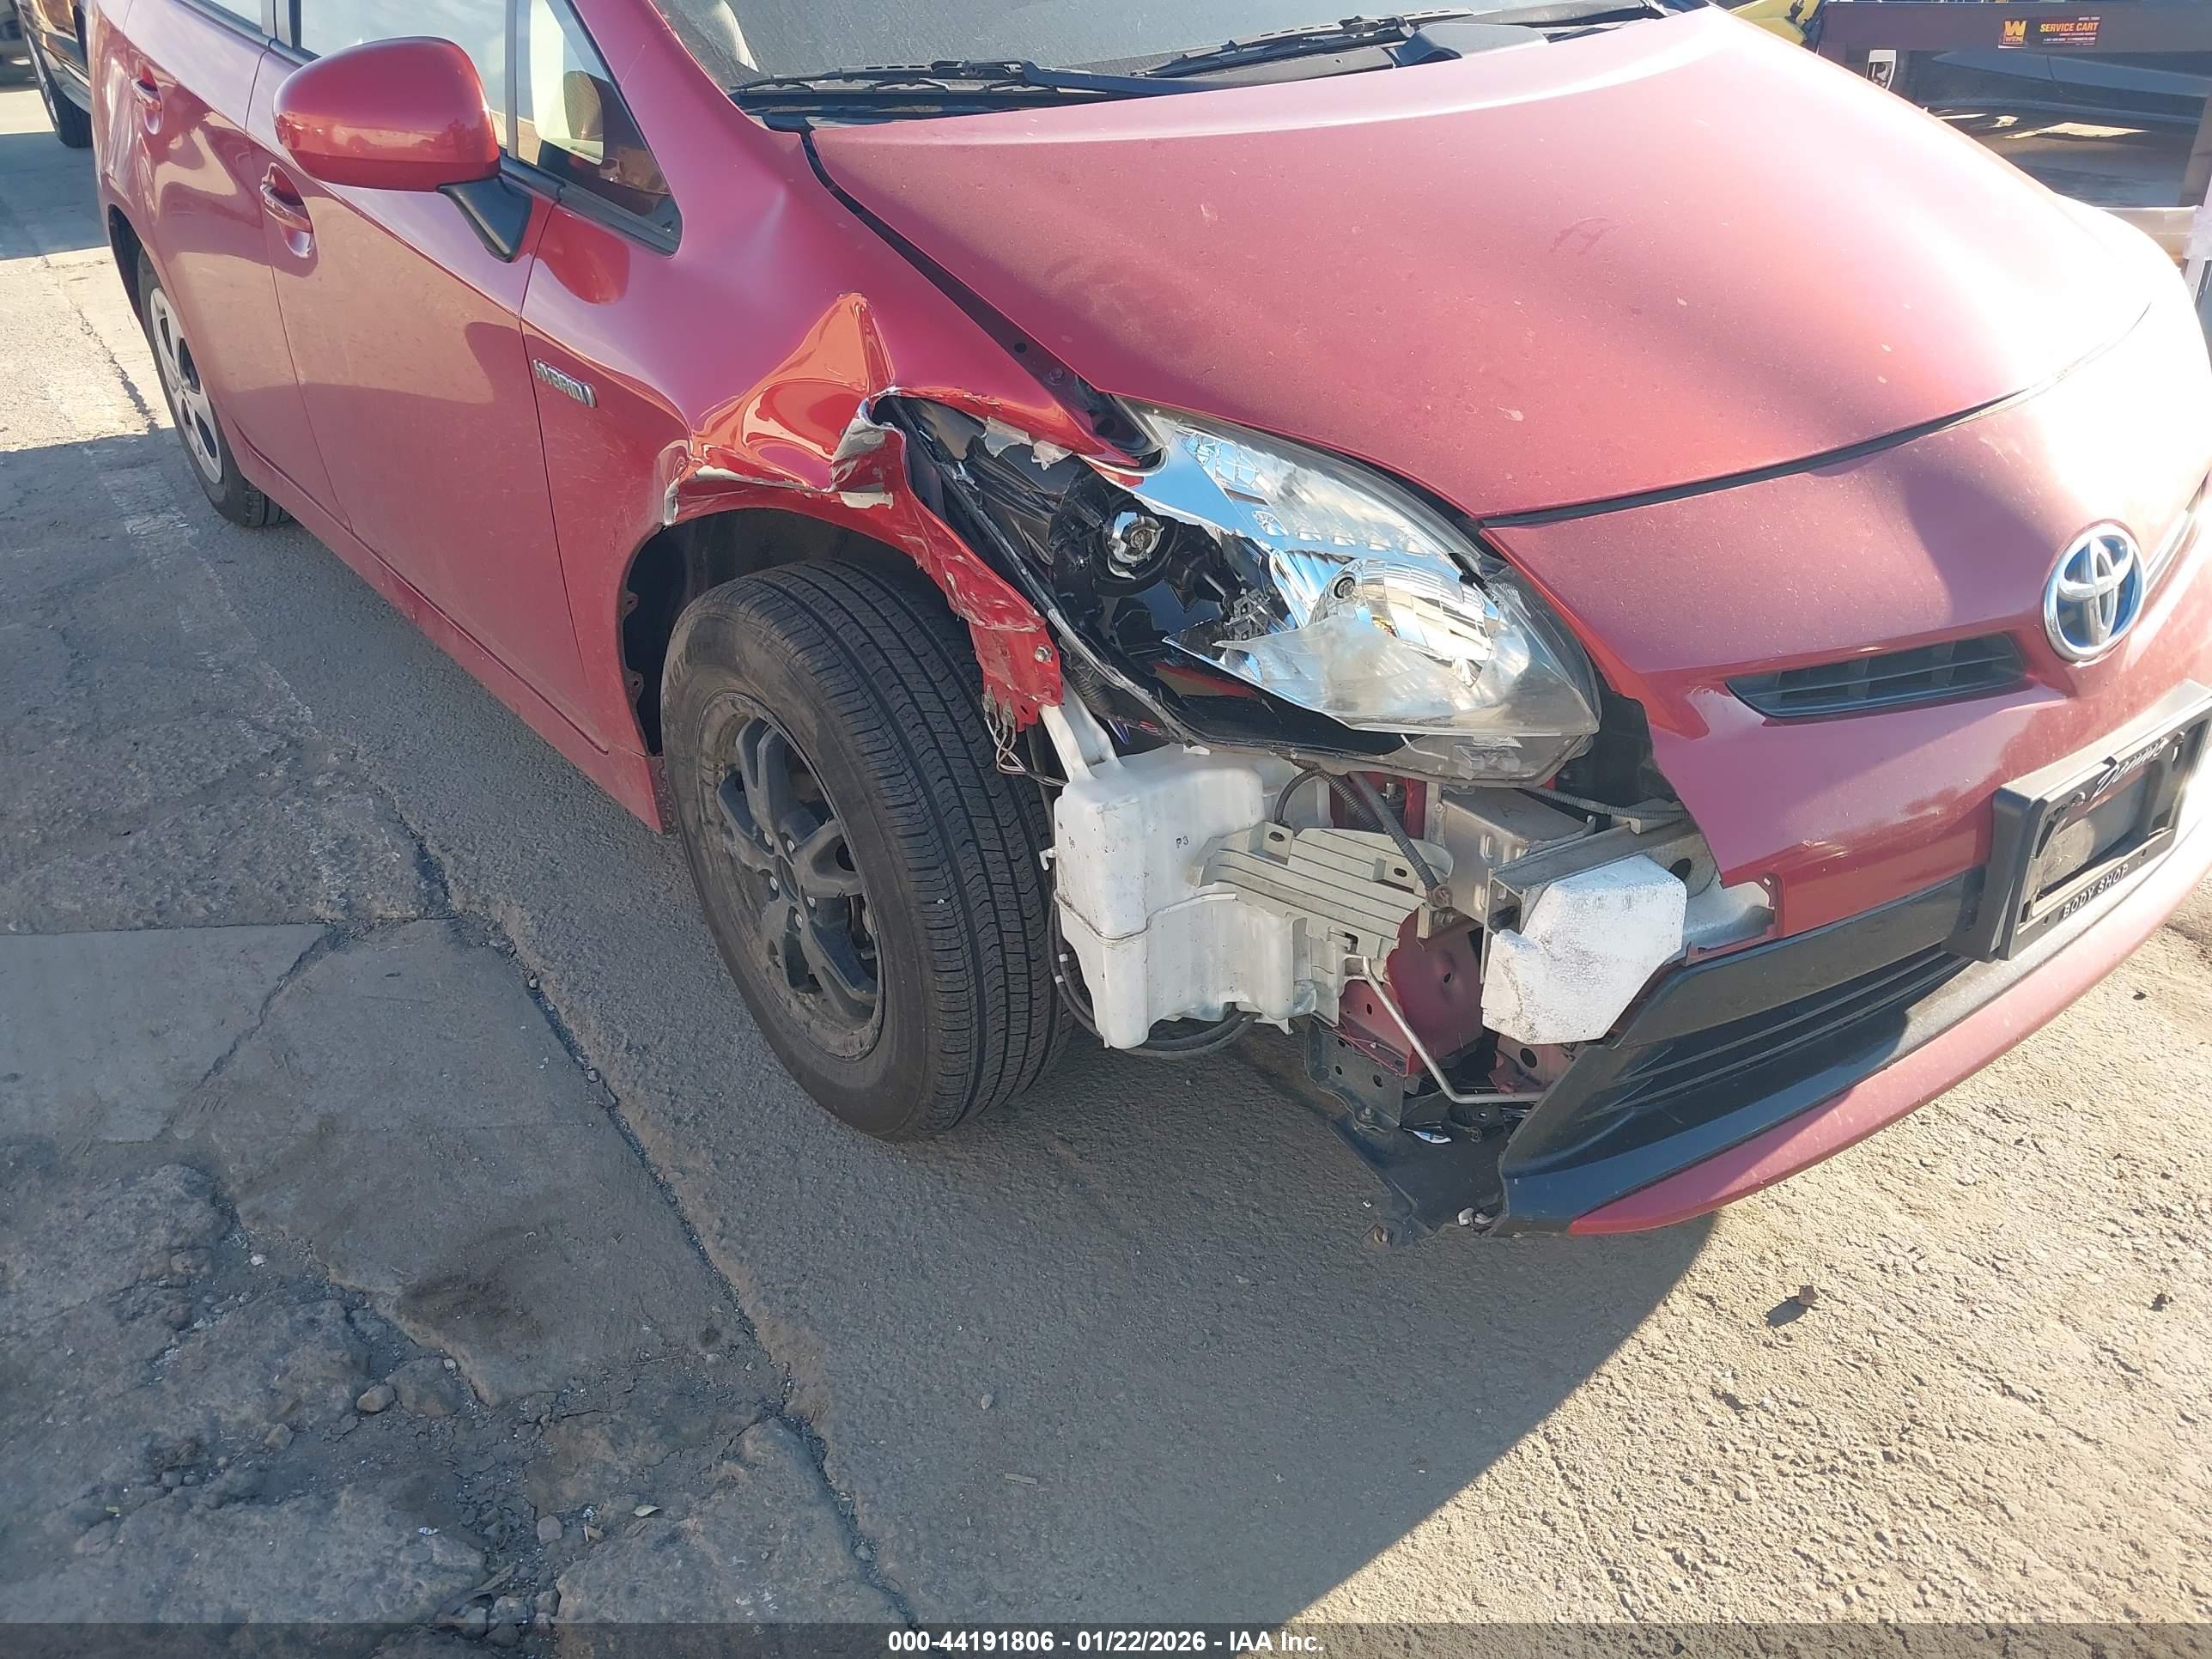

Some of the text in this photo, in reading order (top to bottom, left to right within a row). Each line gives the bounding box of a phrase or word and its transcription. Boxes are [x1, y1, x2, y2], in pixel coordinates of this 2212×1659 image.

[2039, 21, 2100, 33] SERVICE CART
[532, 358, 586, 404] HYBRID
[2062, 862, 2130, 920] BODY SHOP
